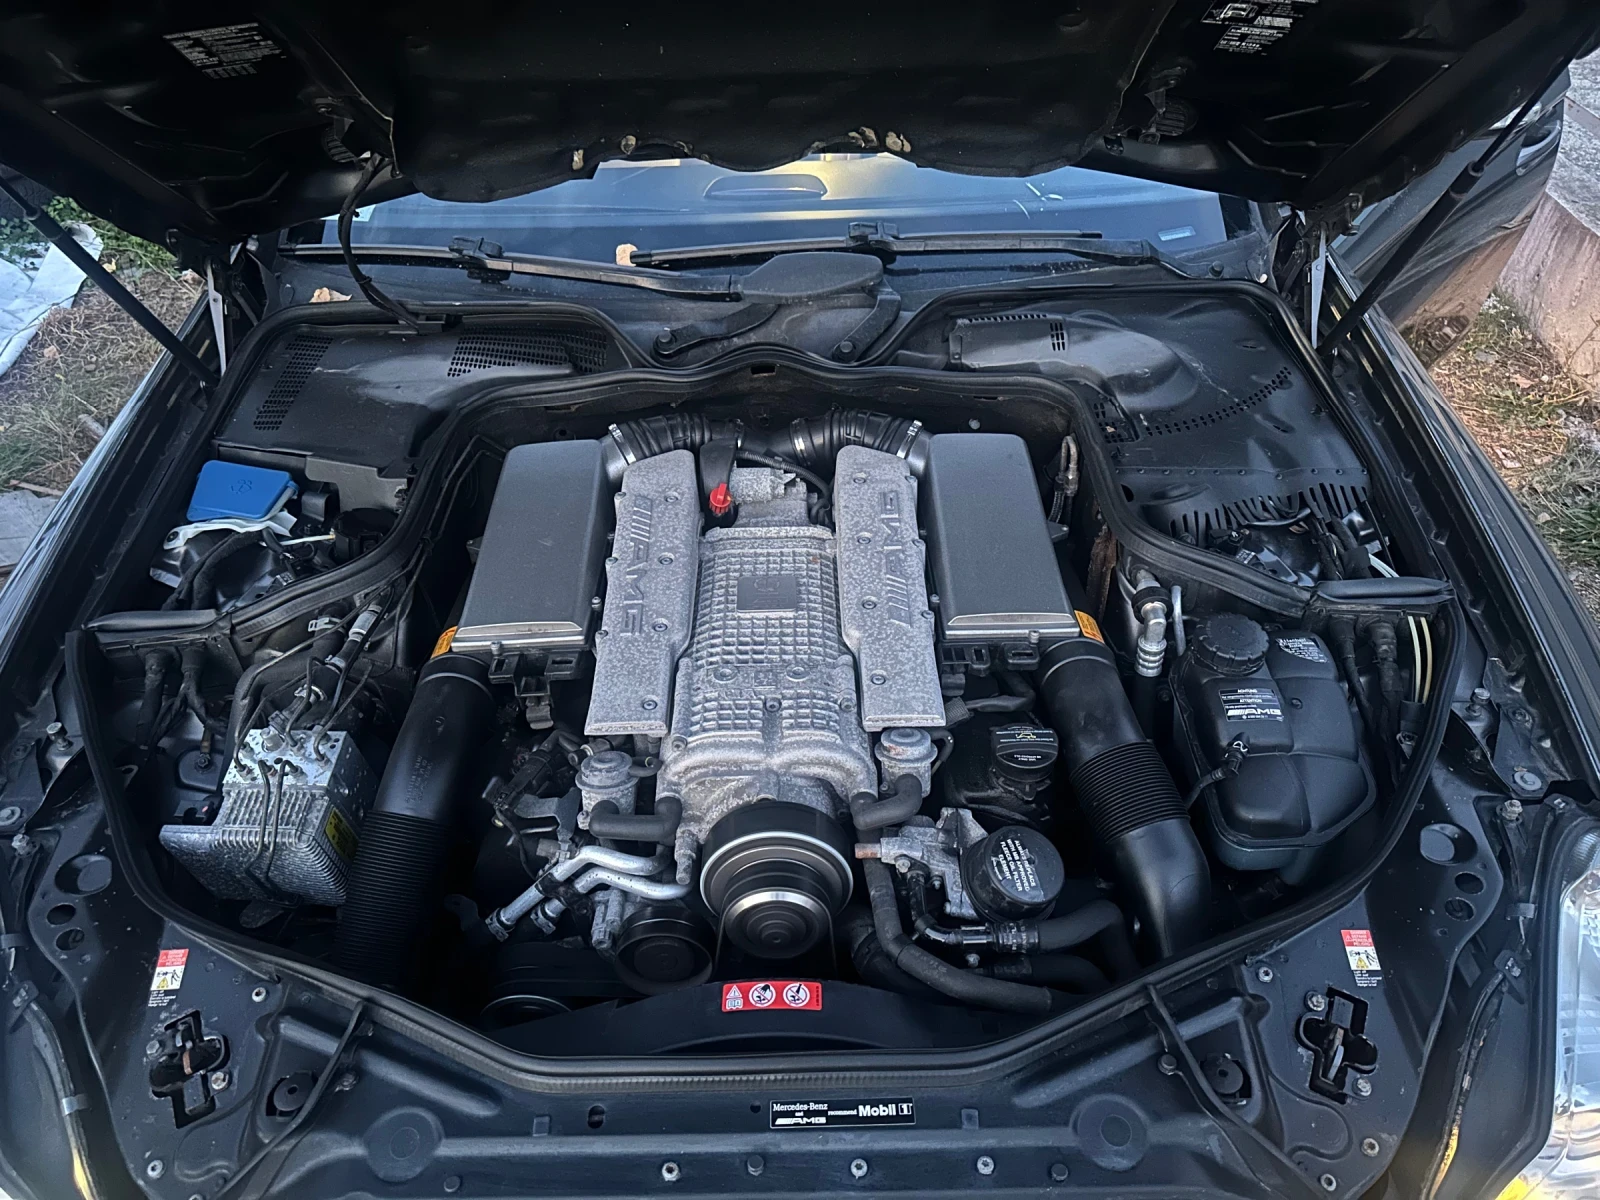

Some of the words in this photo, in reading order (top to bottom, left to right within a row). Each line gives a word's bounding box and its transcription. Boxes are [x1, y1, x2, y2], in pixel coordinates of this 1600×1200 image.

[620, 541, 649, 635] AMG
[998, 854, 1012, 880] ELEMENT
[1000, 841, 1012, 861] FLEECE
[1013, 871, 1022, 891] FILTER
[1007, 839, 1015, 851] WITH
[1016, 861, 1031, 892] APPROVED
[1014, 840, 1027, 860] ALWAYS
[1024, 860, 1036, 887] REPLACE
[772, 1102, 828, 1111] Mercedes-Benz
[858, 1103, 896, 1117] Mobil
